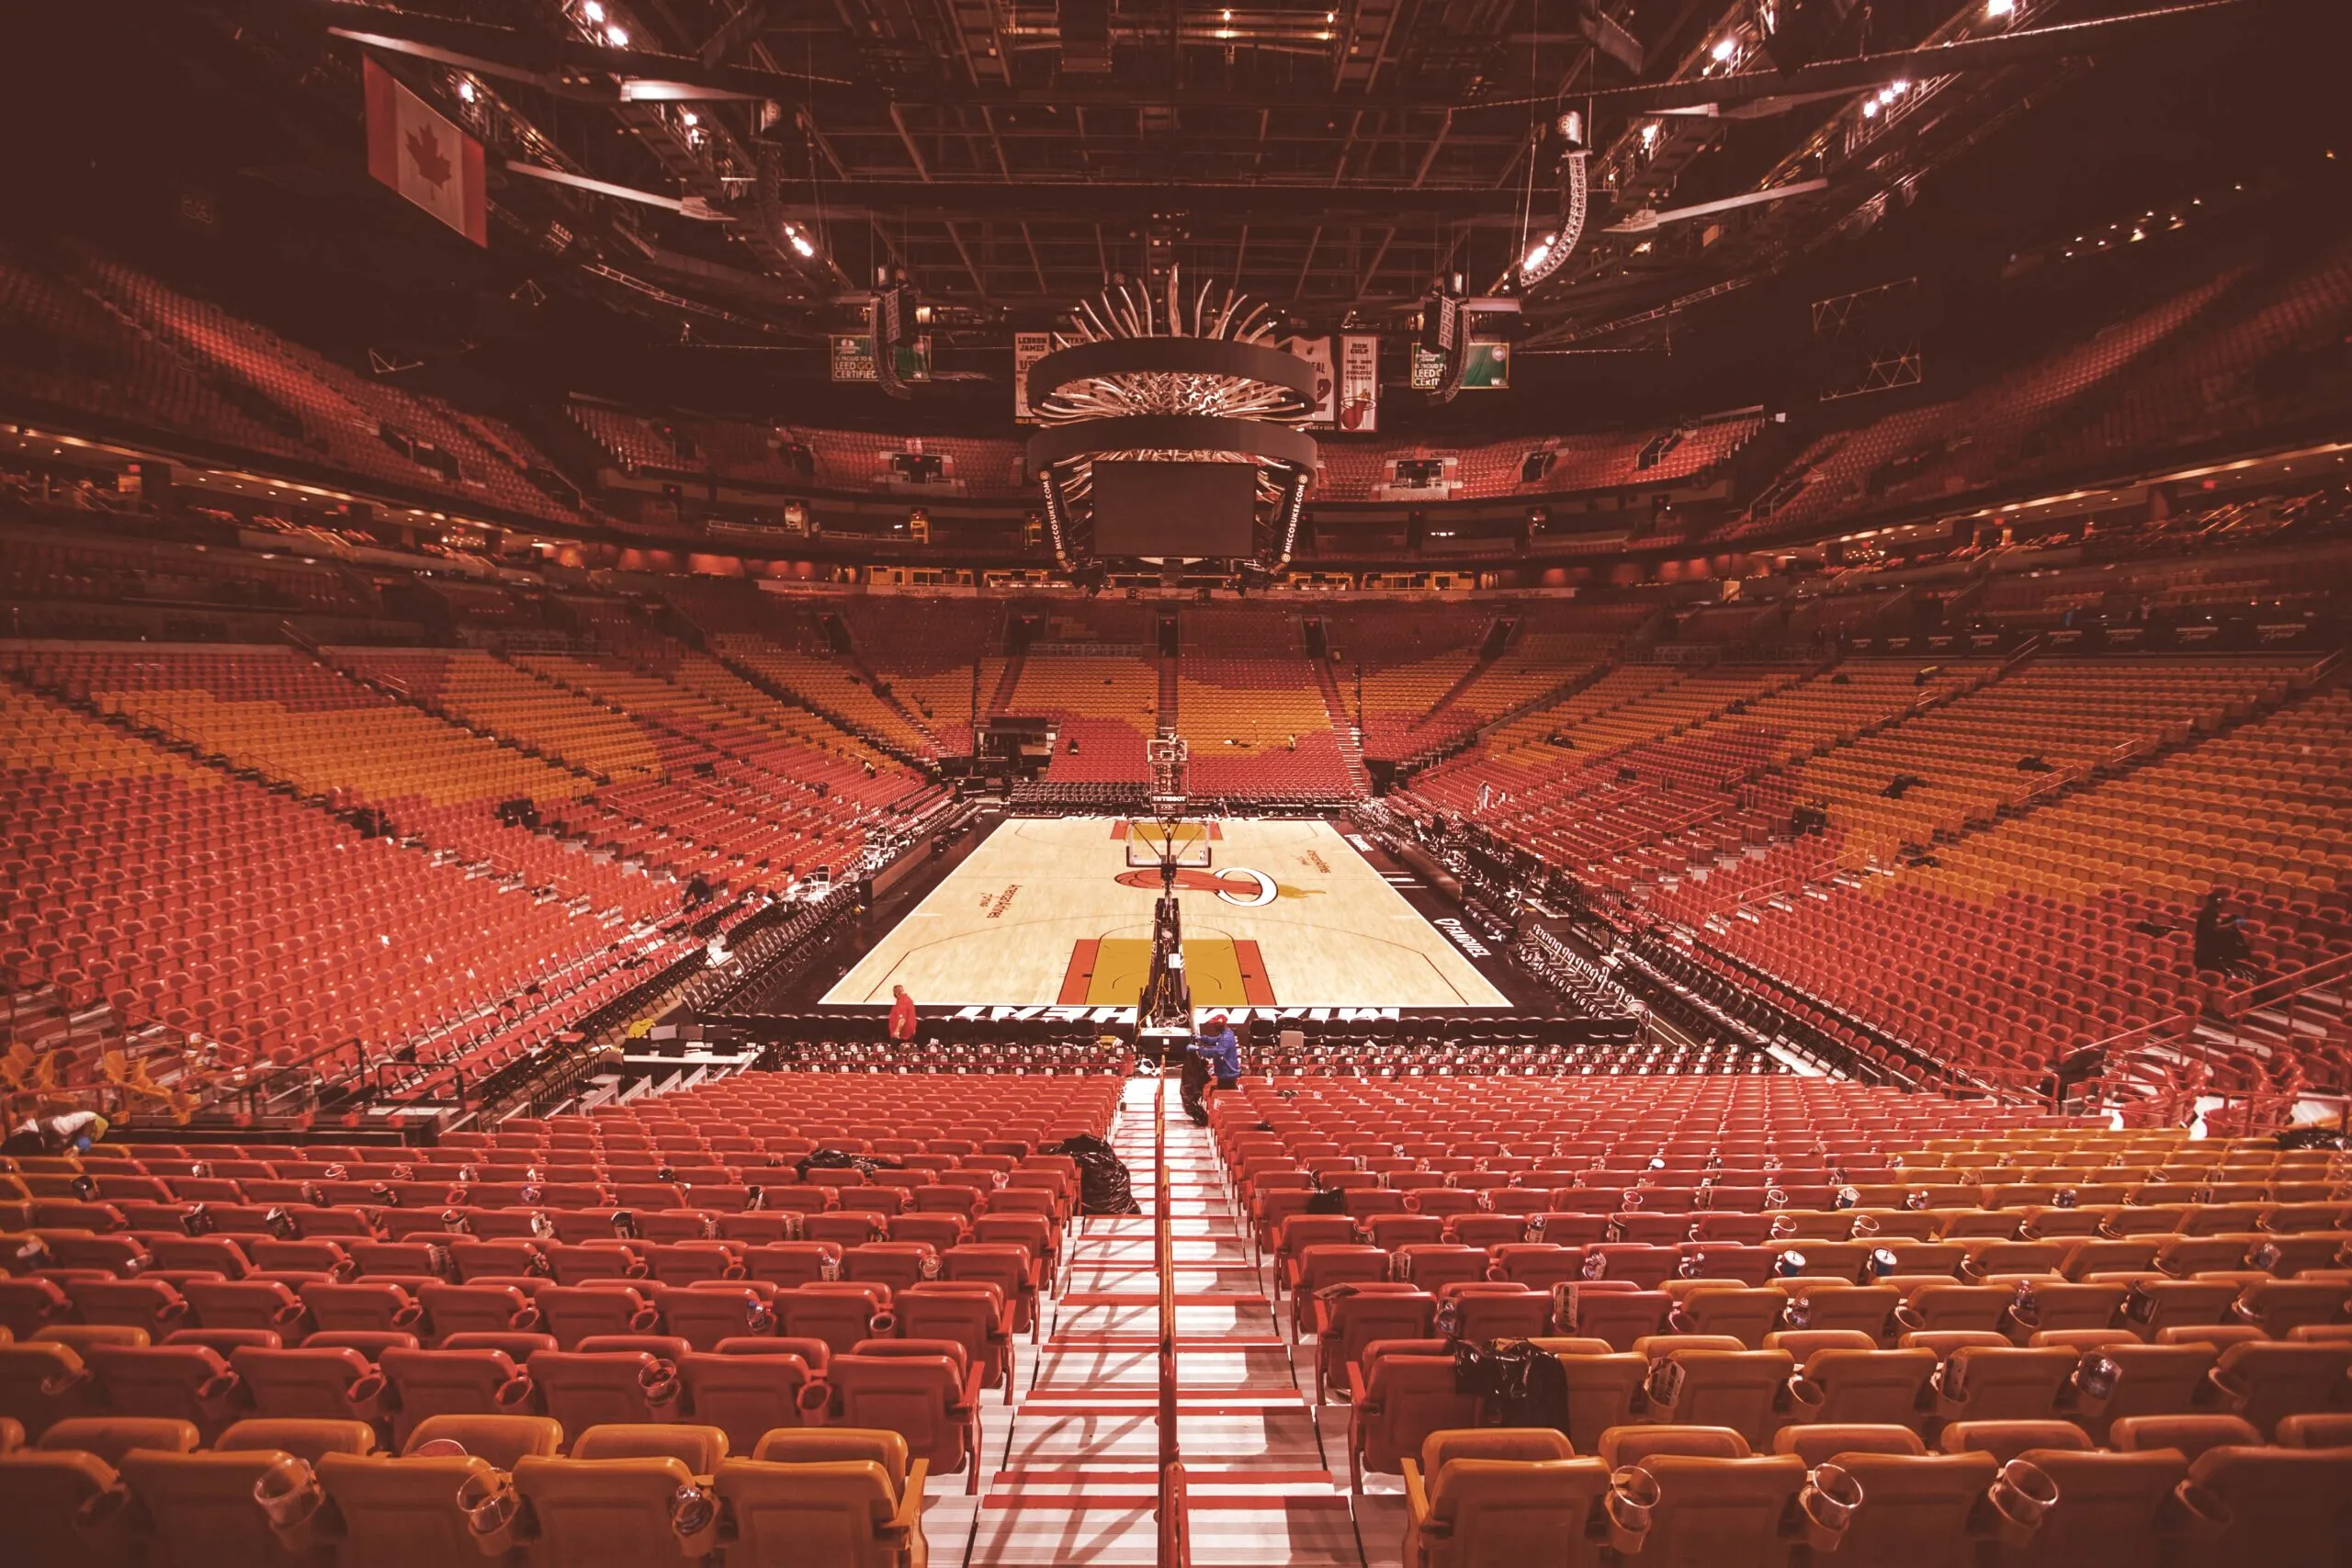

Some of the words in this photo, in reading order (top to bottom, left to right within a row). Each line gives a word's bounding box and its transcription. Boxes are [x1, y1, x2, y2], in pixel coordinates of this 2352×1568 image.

[1414, 369, 1435, 378] LEED
[1043, 480, 1063, 549] MICCOSUKEE.COM
[1284, 484, 1305, 553] MICCOSUKEE.COM
[1442, 926, 1492, 957] FANDUEL
